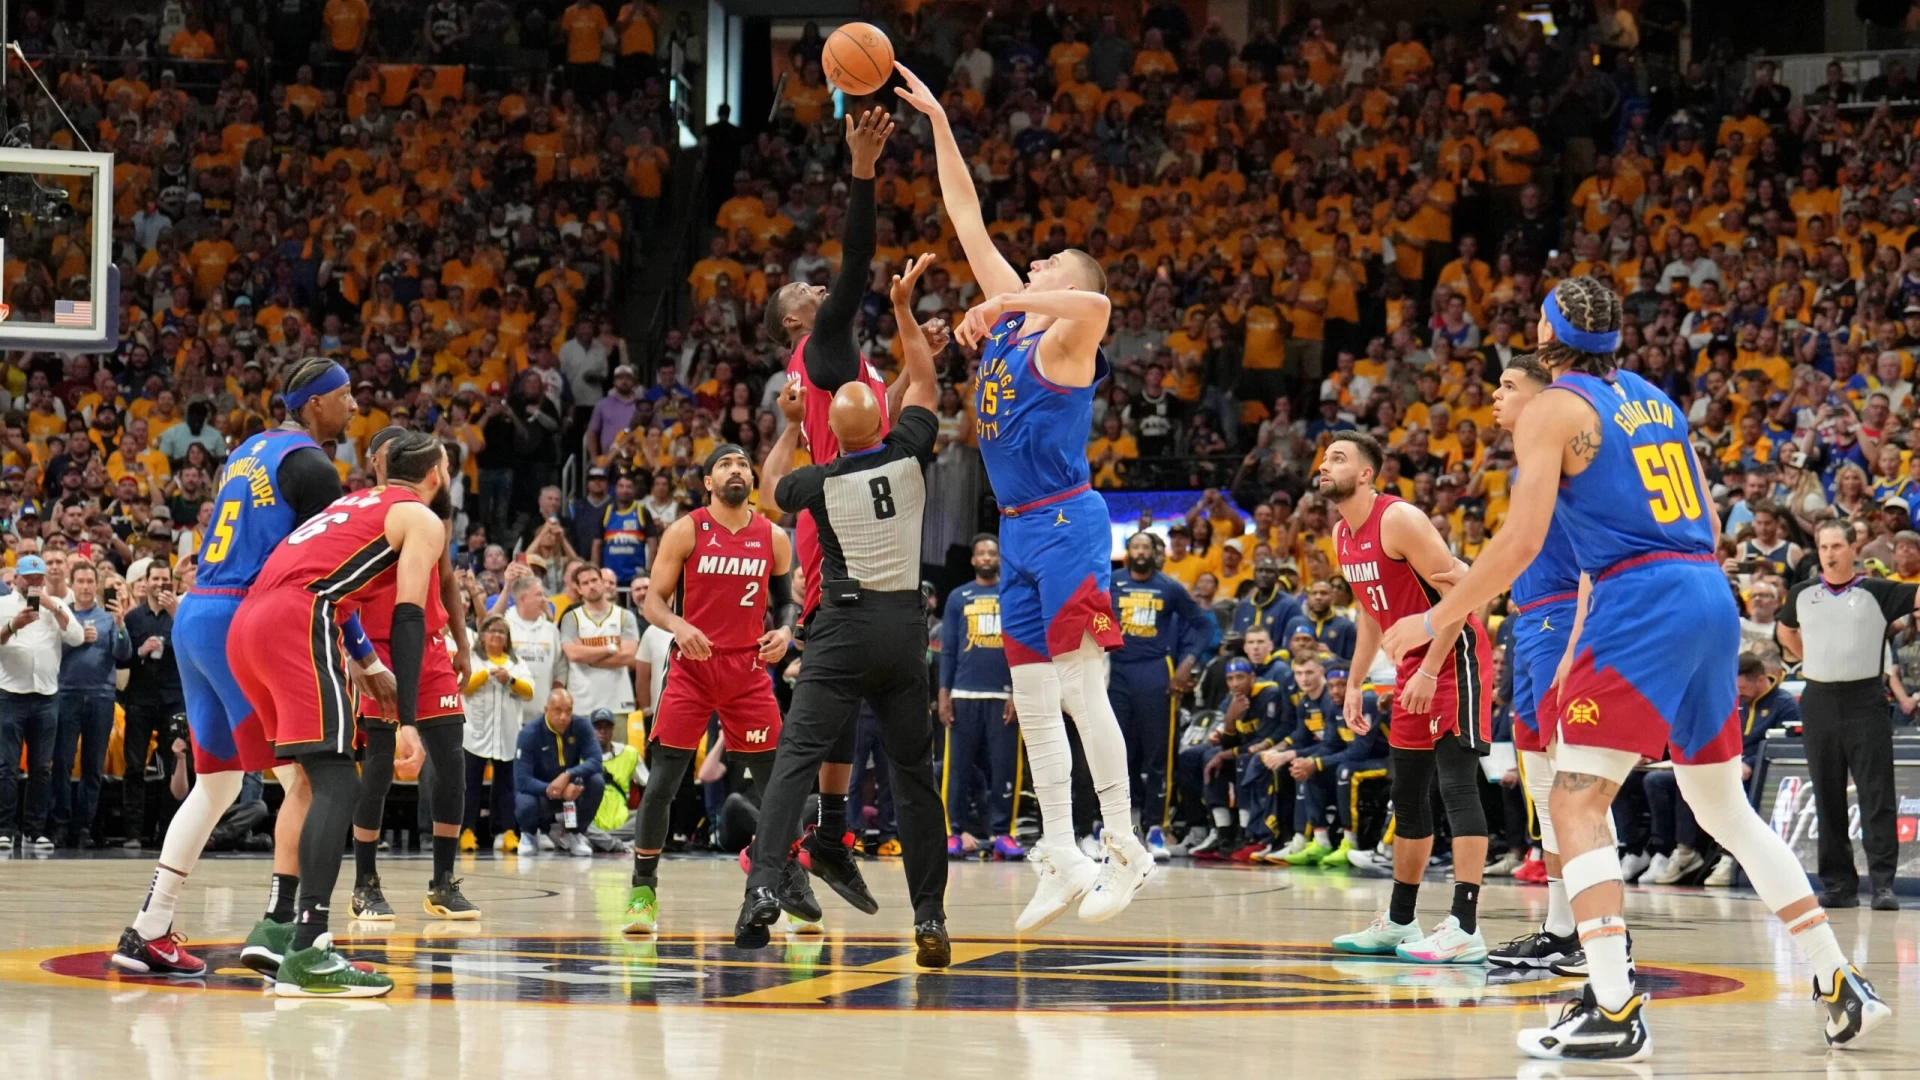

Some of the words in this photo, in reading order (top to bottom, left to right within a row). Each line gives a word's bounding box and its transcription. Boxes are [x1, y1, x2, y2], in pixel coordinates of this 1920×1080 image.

[1006, 319, 1018, 329] 6
[980, 381, 999, 416] 15
[976, 418, 999, 441] CITY
[1613, 399, 1674, 437] GODON
[1631, 441, 1702, 524] 50
[868, 475, 896, 520] 8
[204, 501, 241, 564] 5
[702, 522, 710, 531] 6
[697, 555, 767, 577] MIAMI
[1341, 561, 1380, 583] MIAMI
[739, 581, 760, 607] 2
[1366, 584, 1389, 611] 31
[977, 614, 1002, 634] NBA
